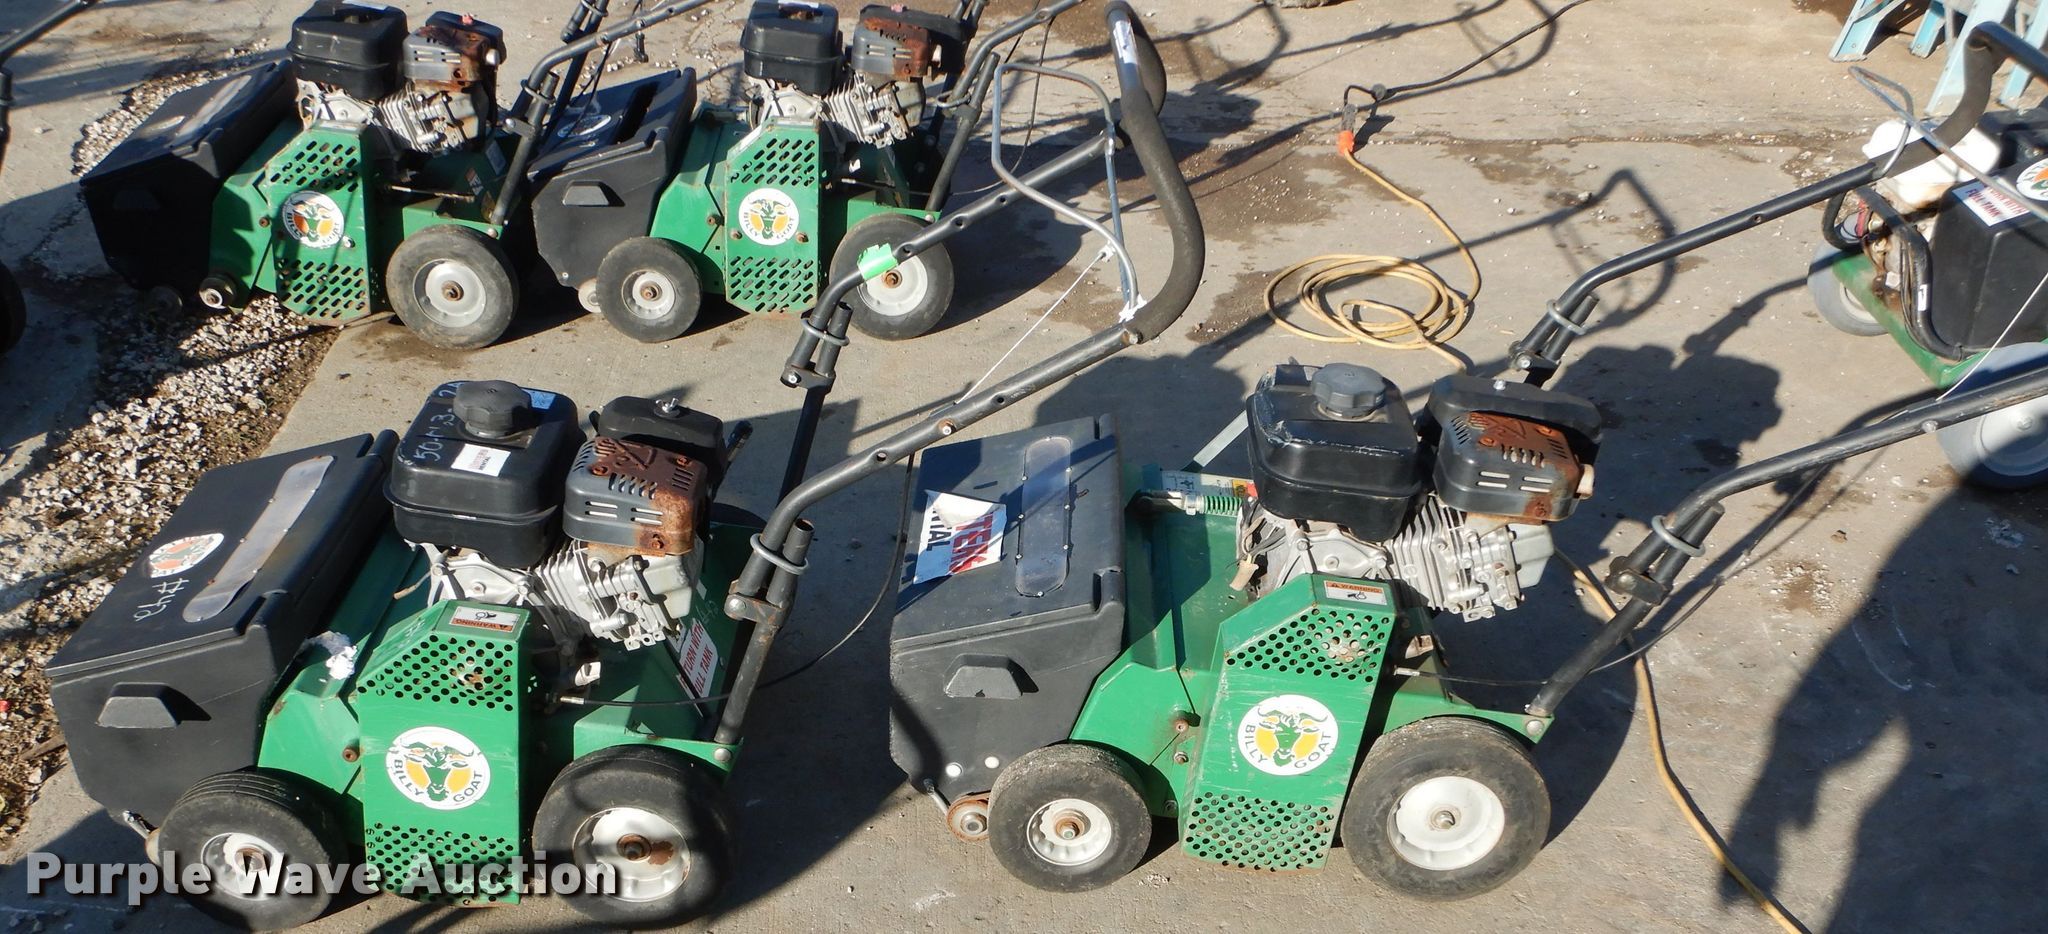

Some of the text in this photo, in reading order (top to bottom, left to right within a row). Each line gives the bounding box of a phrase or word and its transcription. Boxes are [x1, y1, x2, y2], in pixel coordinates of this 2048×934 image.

[1341, 583, 1382, 593] WARNING
[456, 618, 497, 629] WARNING
[694, 643, 714, 695] ULL TANK
[1244, 724, 1332, 769] BILLY GOAT
[393, 759, 483, 802] BILLY GOAT
